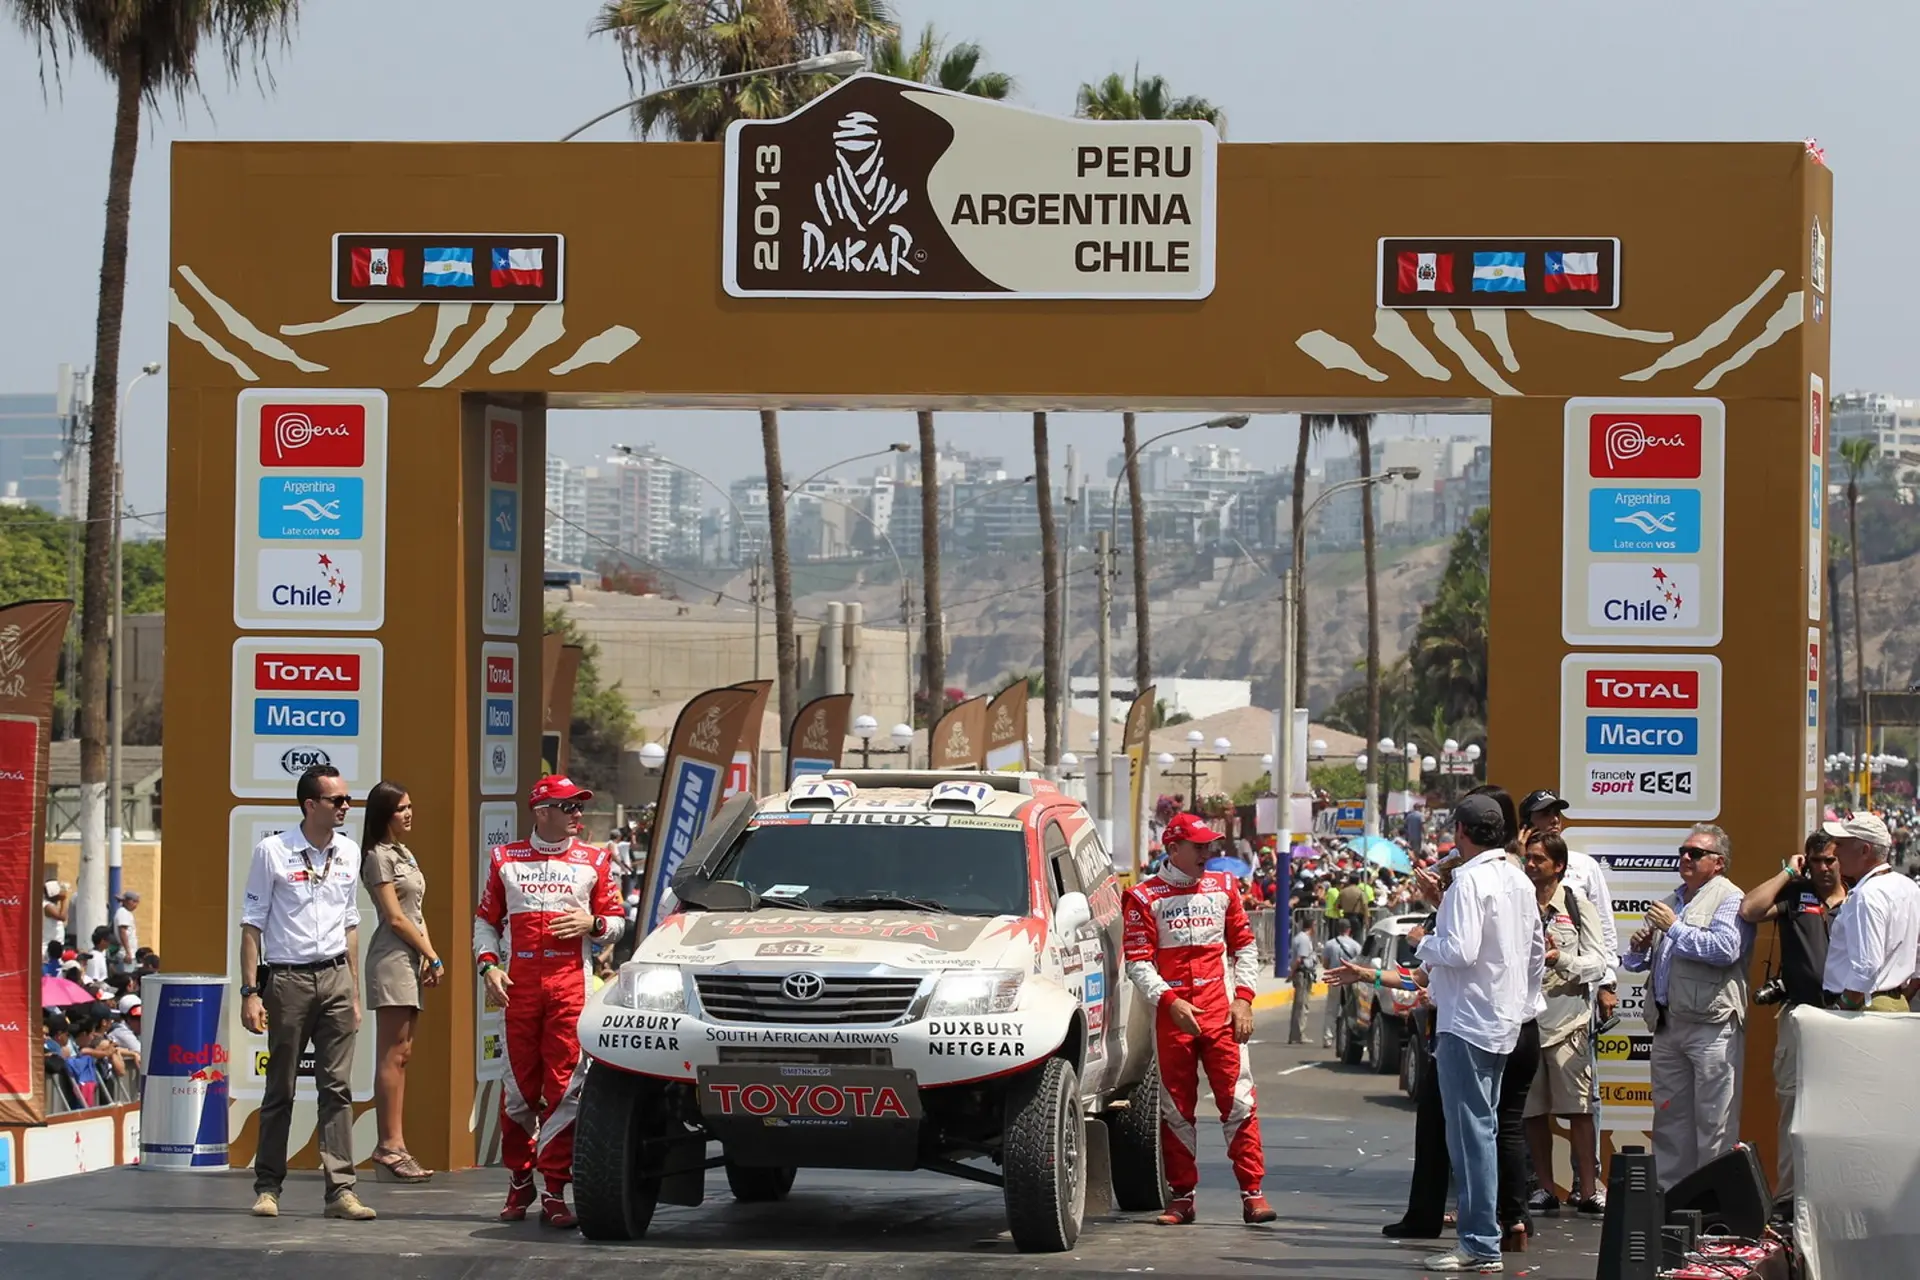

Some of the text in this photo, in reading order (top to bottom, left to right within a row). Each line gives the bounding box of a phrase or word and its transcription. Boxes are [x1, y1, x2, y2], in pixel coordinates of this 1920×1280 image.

[1077, 146, 1191, 178] PERU
[754, 144, 781, 271] 2013
[951, 193, 1192, 225] ARGENTINA
[801, 221, 920, 276] DAKAR
[1075, 241, 1190, 273] CHILE
[275, 412, 349, 459] Perú
[1605, 422, 1685, 470] Perú
[283, 480, 335, 495] Argentina
[1615, 493, 1671, 508] Argentina
[282, 526, 301, 536] Late
[1614, 539, 1676, 549] Late con vos
[272, 585, 332, 606] Chile
[1604, 600, 1667, 621] Chile
[263, 661, 351, 681] TOTAL
[1595, 678, 1689, 698] TOTAL
[267, 705, 346, 727] Macro
[489, 706, 510, 727] Macro
[1600, 724, 1684, 746] Macro
[291, 752, 320, 766] FOX
[1591, 770, 1636, 780] francetv
[1592, 780, 1634, 795] sport
[825, 813, 931, 826] HILUX
[952, 819, 1020, 830] dakar.com
[516, 871, 577, 884] IMPERIAL
[520, 884, 573, 895] TOYOTA
[1162, 905, 1218, 919] IMPERIAL
[1167, 917, 1214, 930] TOYOTA
[725, 923, 939, 942] TOYOTA
[602, 1015, 681, 1031] DUXBURY
[929, 1022, 1024, 1036] DUXBURY
[598, 1034, 680, 1051] NETGEAR
[706, 1028, 899, 1045] SOUTH AFRICAN AIRWAYS
[168, 1044, 208, 1065] Red
[929, 1042, 1025, 1057] NETGEAR
[709, 1083, 910, 1118] TOYOTA
